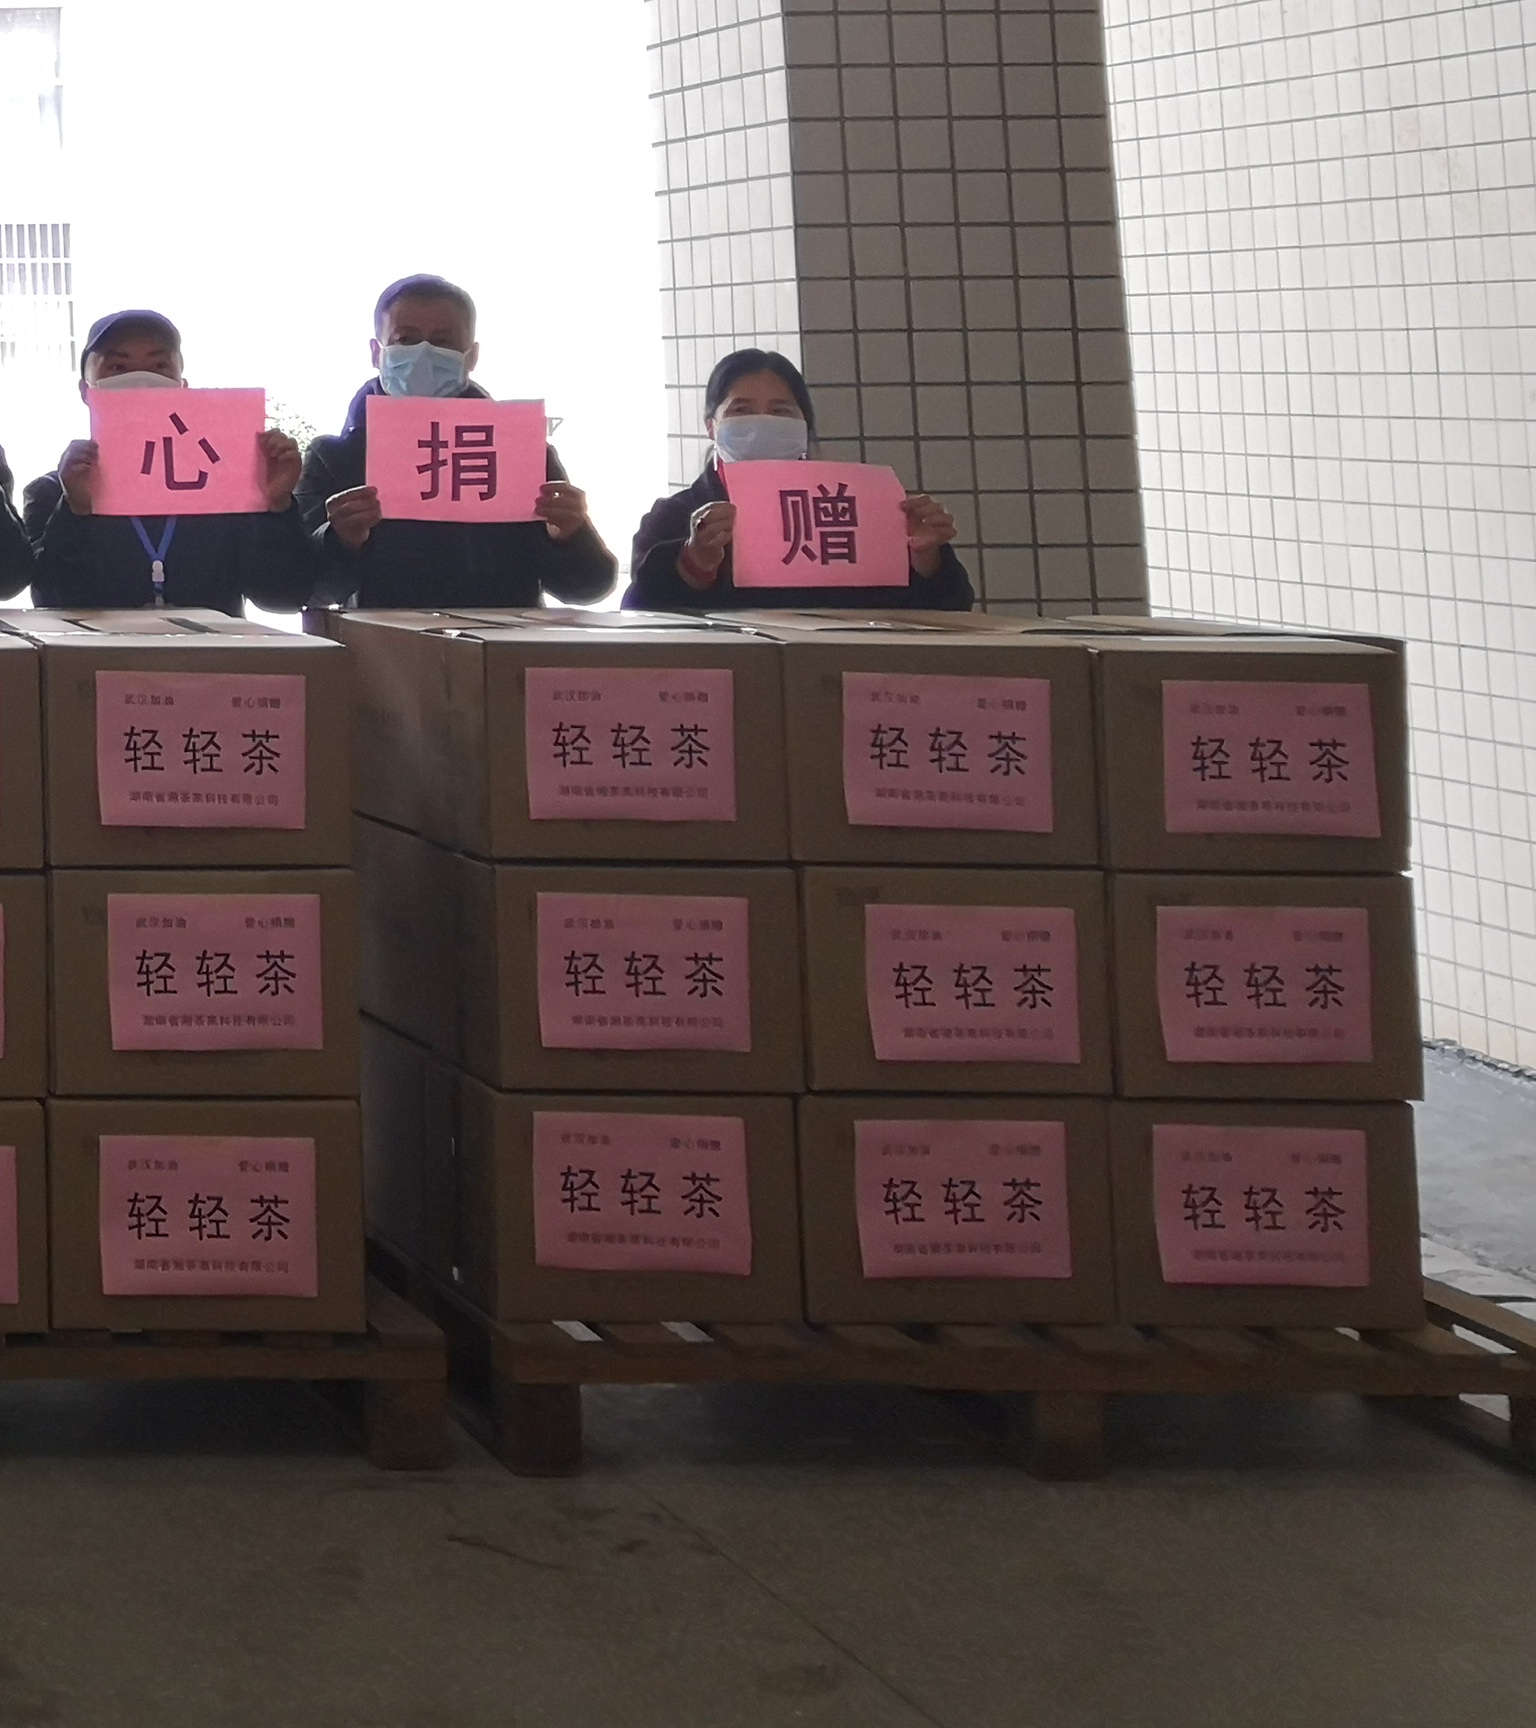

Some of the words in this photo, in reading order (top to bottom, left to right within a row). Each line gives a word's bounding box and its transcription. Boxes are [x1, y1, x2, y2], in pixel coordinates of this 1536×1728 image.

[140, 412, 221, 491] 心
[415, 421, 497, 502] 捐
[778, 482, 859, 566] 赠
[123, 725, 281, 776] 轻轻茶
[551, 721, 710, 769] 轻轻茶
[869, 723, 1028, 777] 轻轻茶
[1190, 735, 1350, 784] 轻轻茶
[135, 949, 297, 998] 轻轻茶
[563, 949, 725, 999] 轻轻茶
[892, 961, 1054, 1010] 轻轻茶
[1184, 961, 1345, 1010] 轻轻茶
[126, 1191, 291, 1242] 轻轻茶
[559, 1165, 723, 1219] 轻轻茶
[882, 1176, 1043, 1226] 轻轻茶
[1181, 1183, 1346, 1234] 轻轻茶
